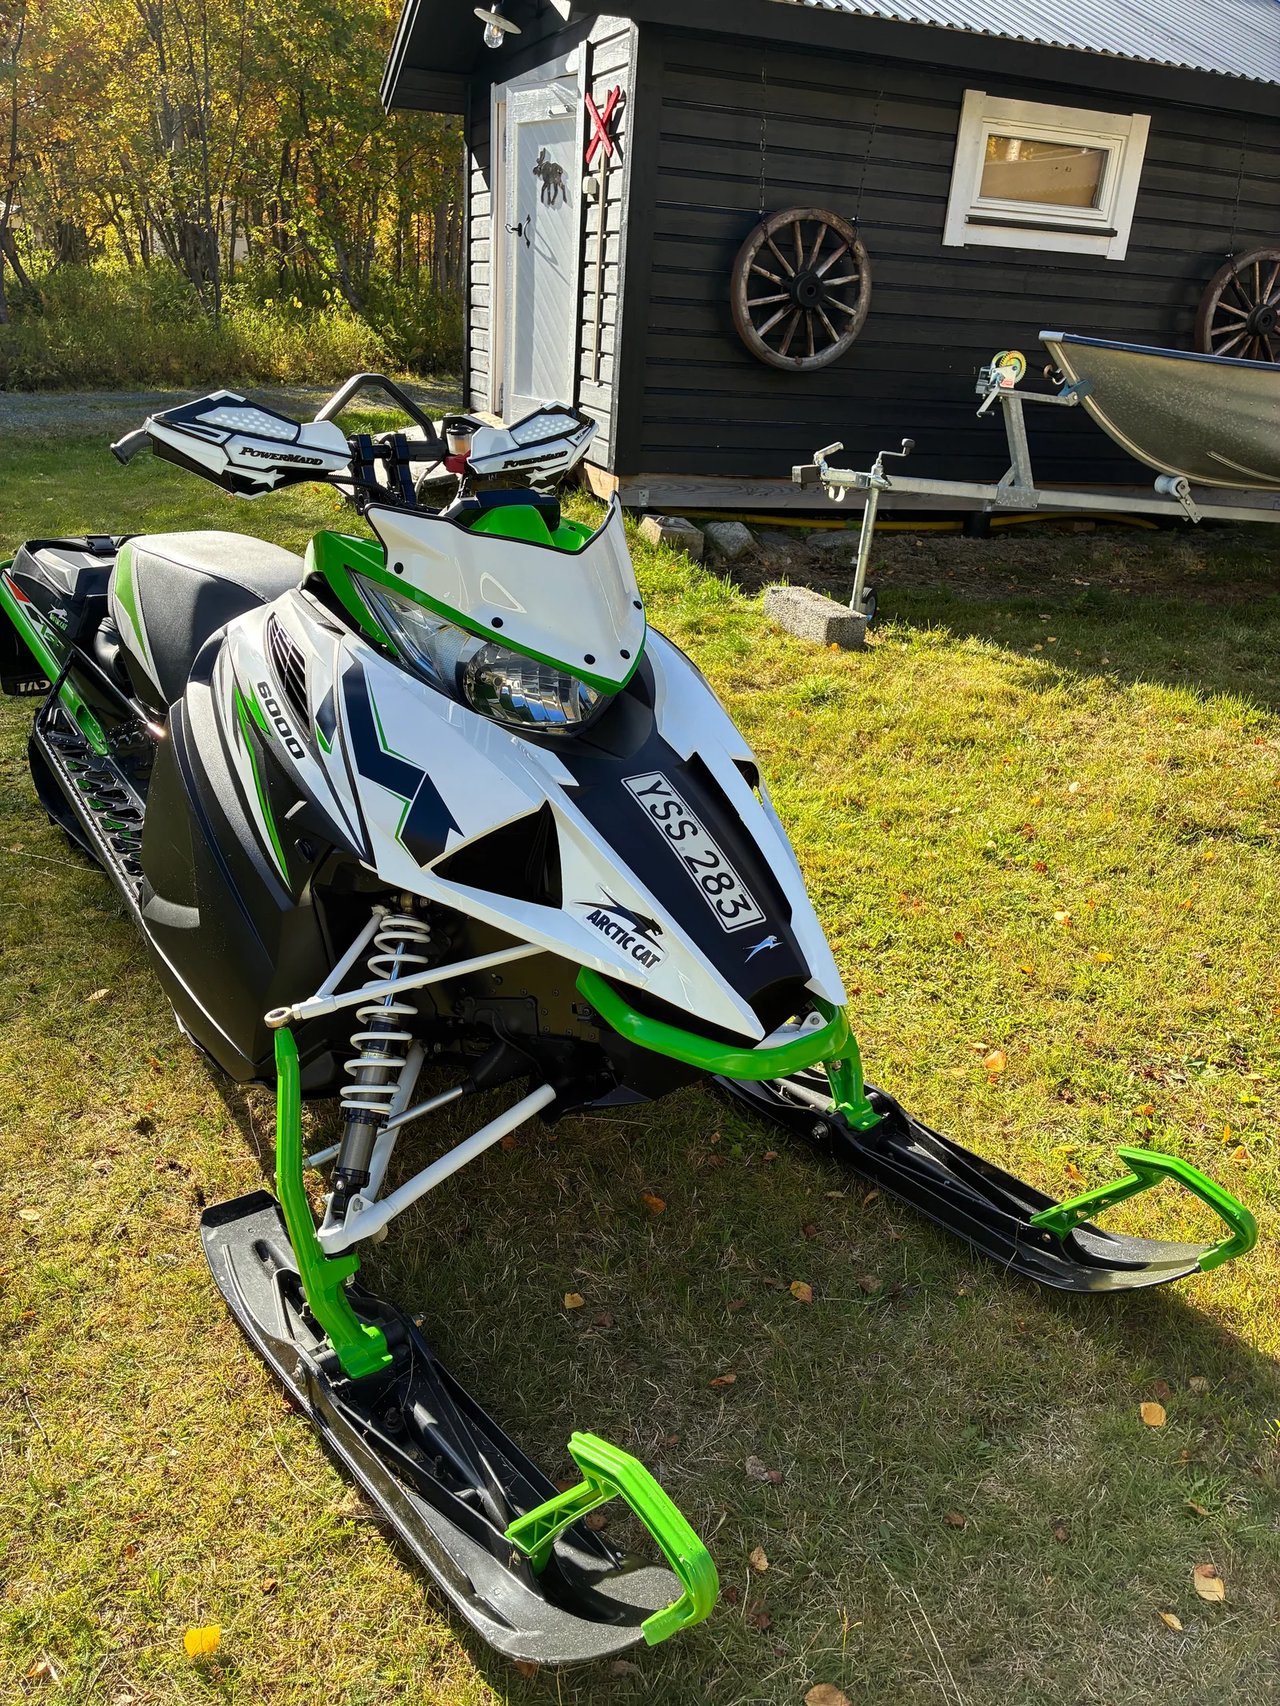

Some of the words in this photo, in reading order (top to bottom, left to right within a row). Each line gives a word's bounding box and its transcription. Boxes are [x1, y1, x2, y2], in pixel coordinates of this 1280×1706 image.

[257, 681, 305, 759] 6000
[636, 780, 698, 841] YSS
[683, 850, 752, 918] 283
[586, 908, 635, 951] ARCTIC
[631, 944, 661, 970] CAT
